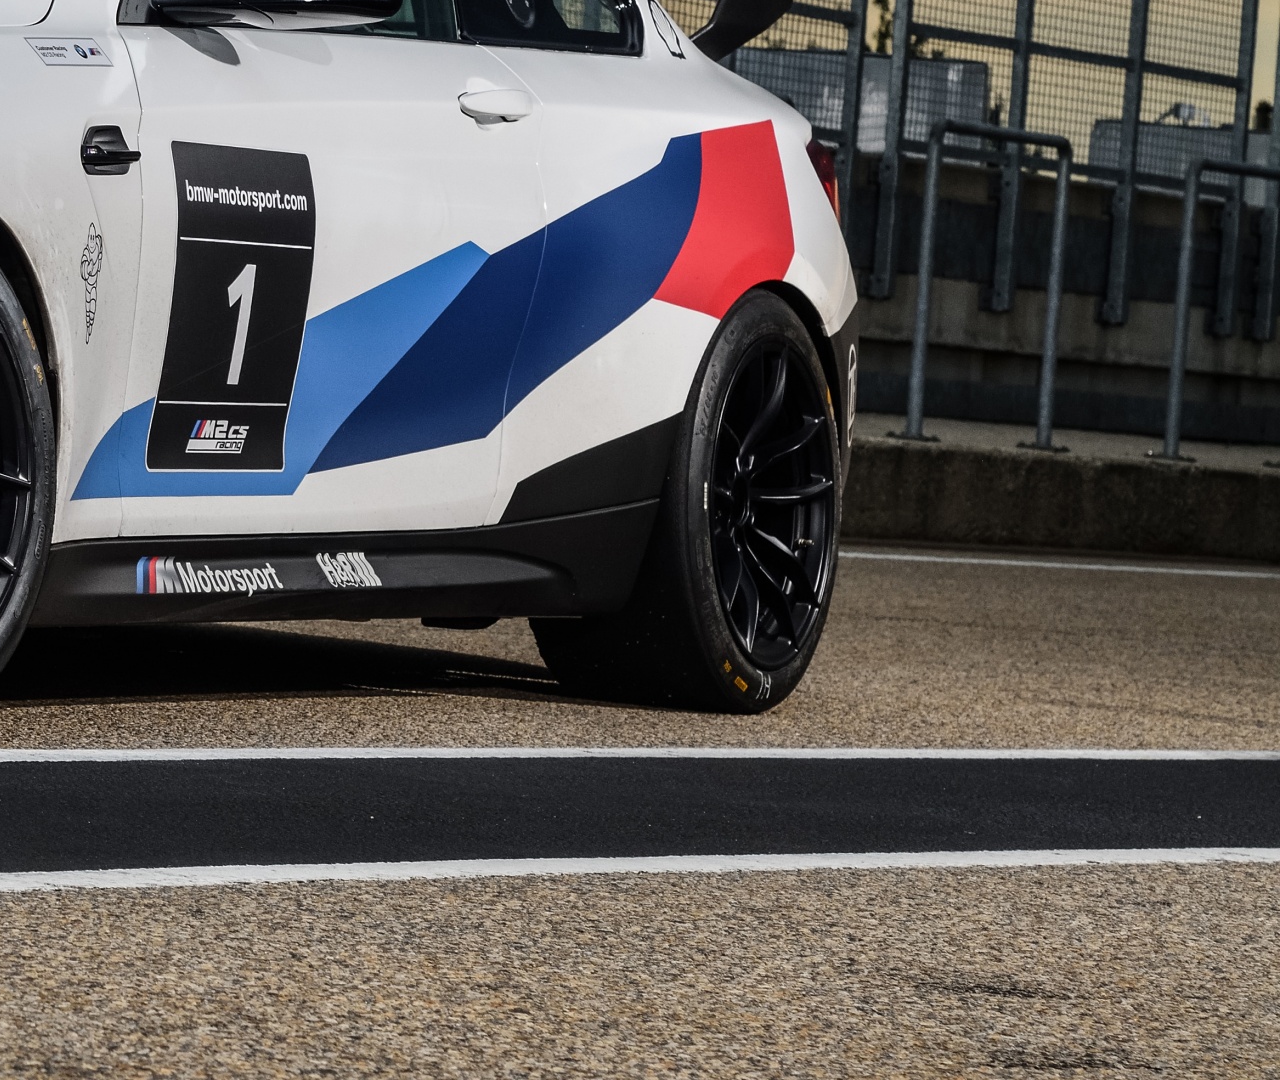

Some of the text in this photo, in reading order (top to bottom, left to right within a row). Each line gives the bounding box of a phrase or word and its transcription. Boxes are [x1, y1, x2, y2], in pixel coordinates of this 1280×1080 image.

[185, 179, 308, 212] bmw-motorsport.com
[226, 263, 257, 385] 1
[215, 441, 242, 451] racing
[175, 561, 284, 597] Motorsport
